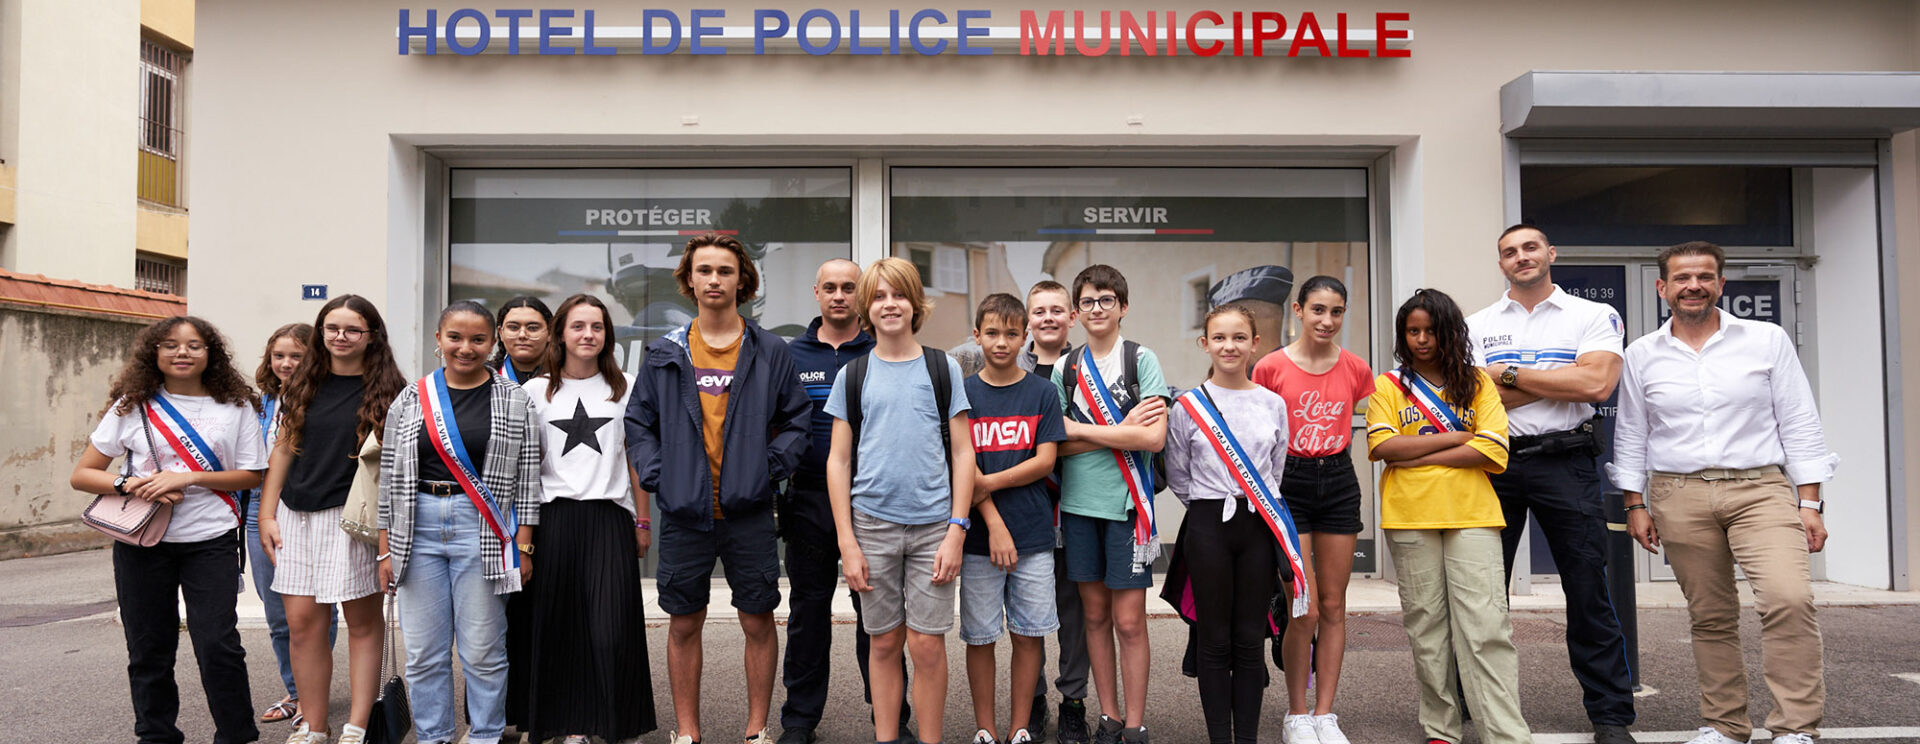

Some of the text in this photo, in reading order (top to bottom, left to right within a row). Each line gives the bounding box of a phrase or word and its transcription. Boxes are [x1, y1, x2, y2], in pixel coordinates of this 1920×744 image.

[397, 9, 1412, 58] HOTEL DE POLICE MUNICIPALE
[585, 205, 712, 225] PROTÉGER
[1083, 207, 1169, 223] SERVIR
[310, 287, 320, 297] 14
[1584, 288, 1597, 299] 19
[1600, 288, 1614, 299] 39
[1661, 295, 1773, 317] PICE
[1483, 335, 1513, 344] POLICE
[799, 371, 826, 381] OLICE
[1085, 374, 1096, 391] CMJ
[1094, 393, 1109, 418] VILLE
[1293, 391, 1345, 423] Loca
[1398, 405, 1420, 428] LOS
[1431, 407, 1446, 423] CMJ
[179, 436, 196, 453] CMJ
[439, 428, 453, 455] VILLE
[973, 421, 1030, 447] NASA
[1211, 425, 1281, 522] CMJ VILLE D'AUBAGNE
